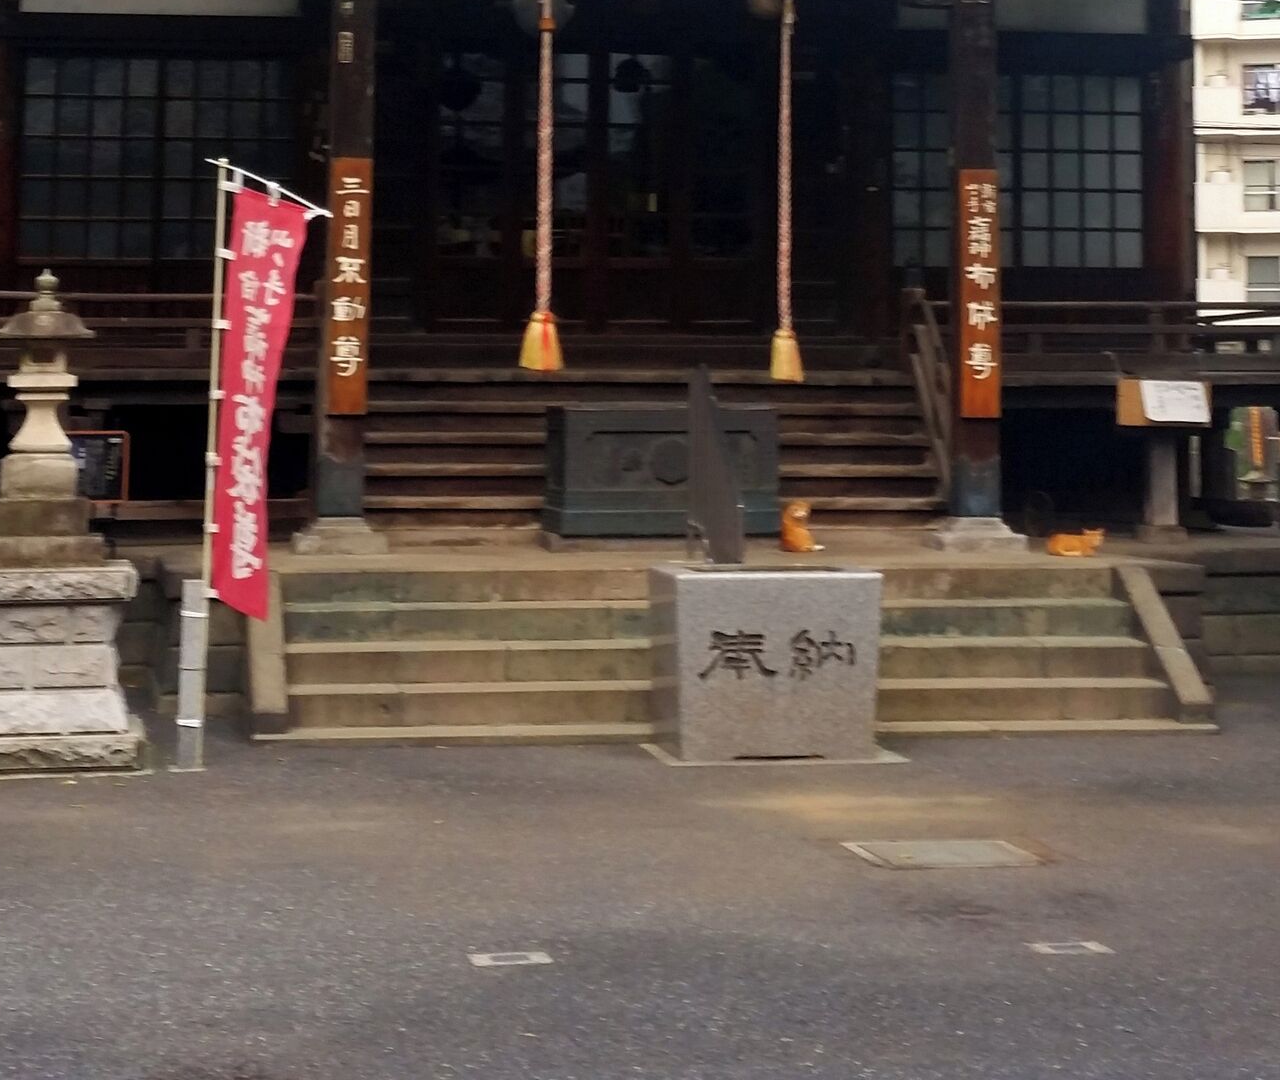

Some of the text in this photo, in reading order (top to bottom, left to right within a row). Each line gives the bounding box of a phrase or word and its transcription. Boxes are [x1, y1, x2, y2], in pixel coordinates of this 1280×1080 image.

[330, 177, 370, 376] 三日月不動尊
[698, 628, 857, 681] 奉納
